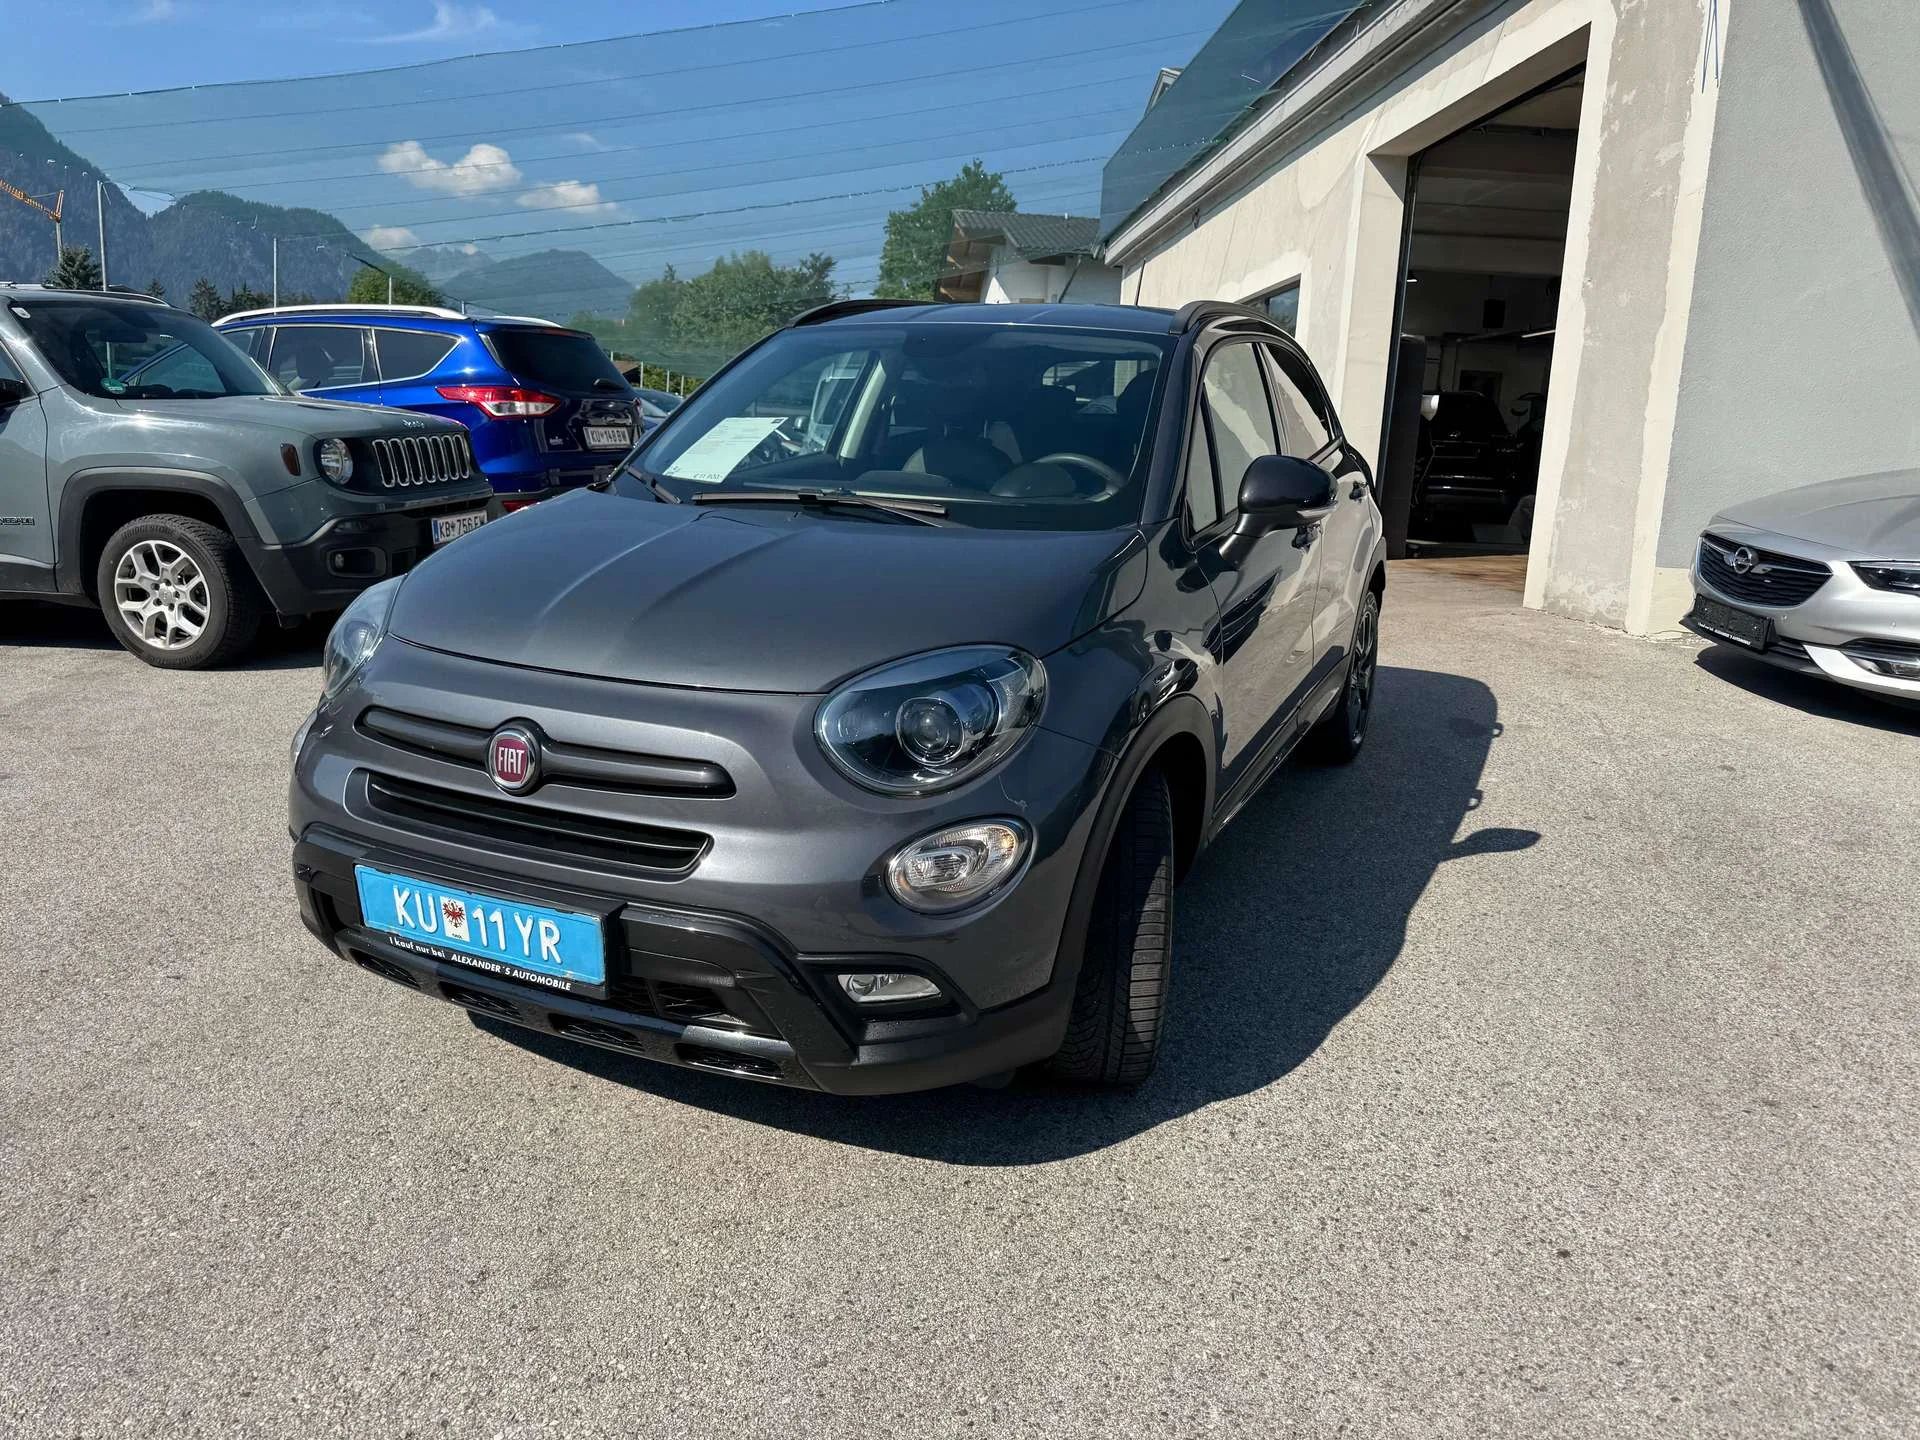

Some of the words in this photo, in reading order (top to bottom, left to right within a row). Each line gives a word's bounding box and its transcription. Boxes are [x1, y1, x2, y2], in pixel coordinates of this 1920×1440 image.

[439, 520, 451, 538] KB
[499, 747, 525, 774] FIAT
[393, 885, 437, 933] KU
[394, 938, 415, 951] kauf
[415, 944, 430, 955] nur
[431, 946, 446, 958] bei
[512, 970, 572, 991] AUTOMOBILE
